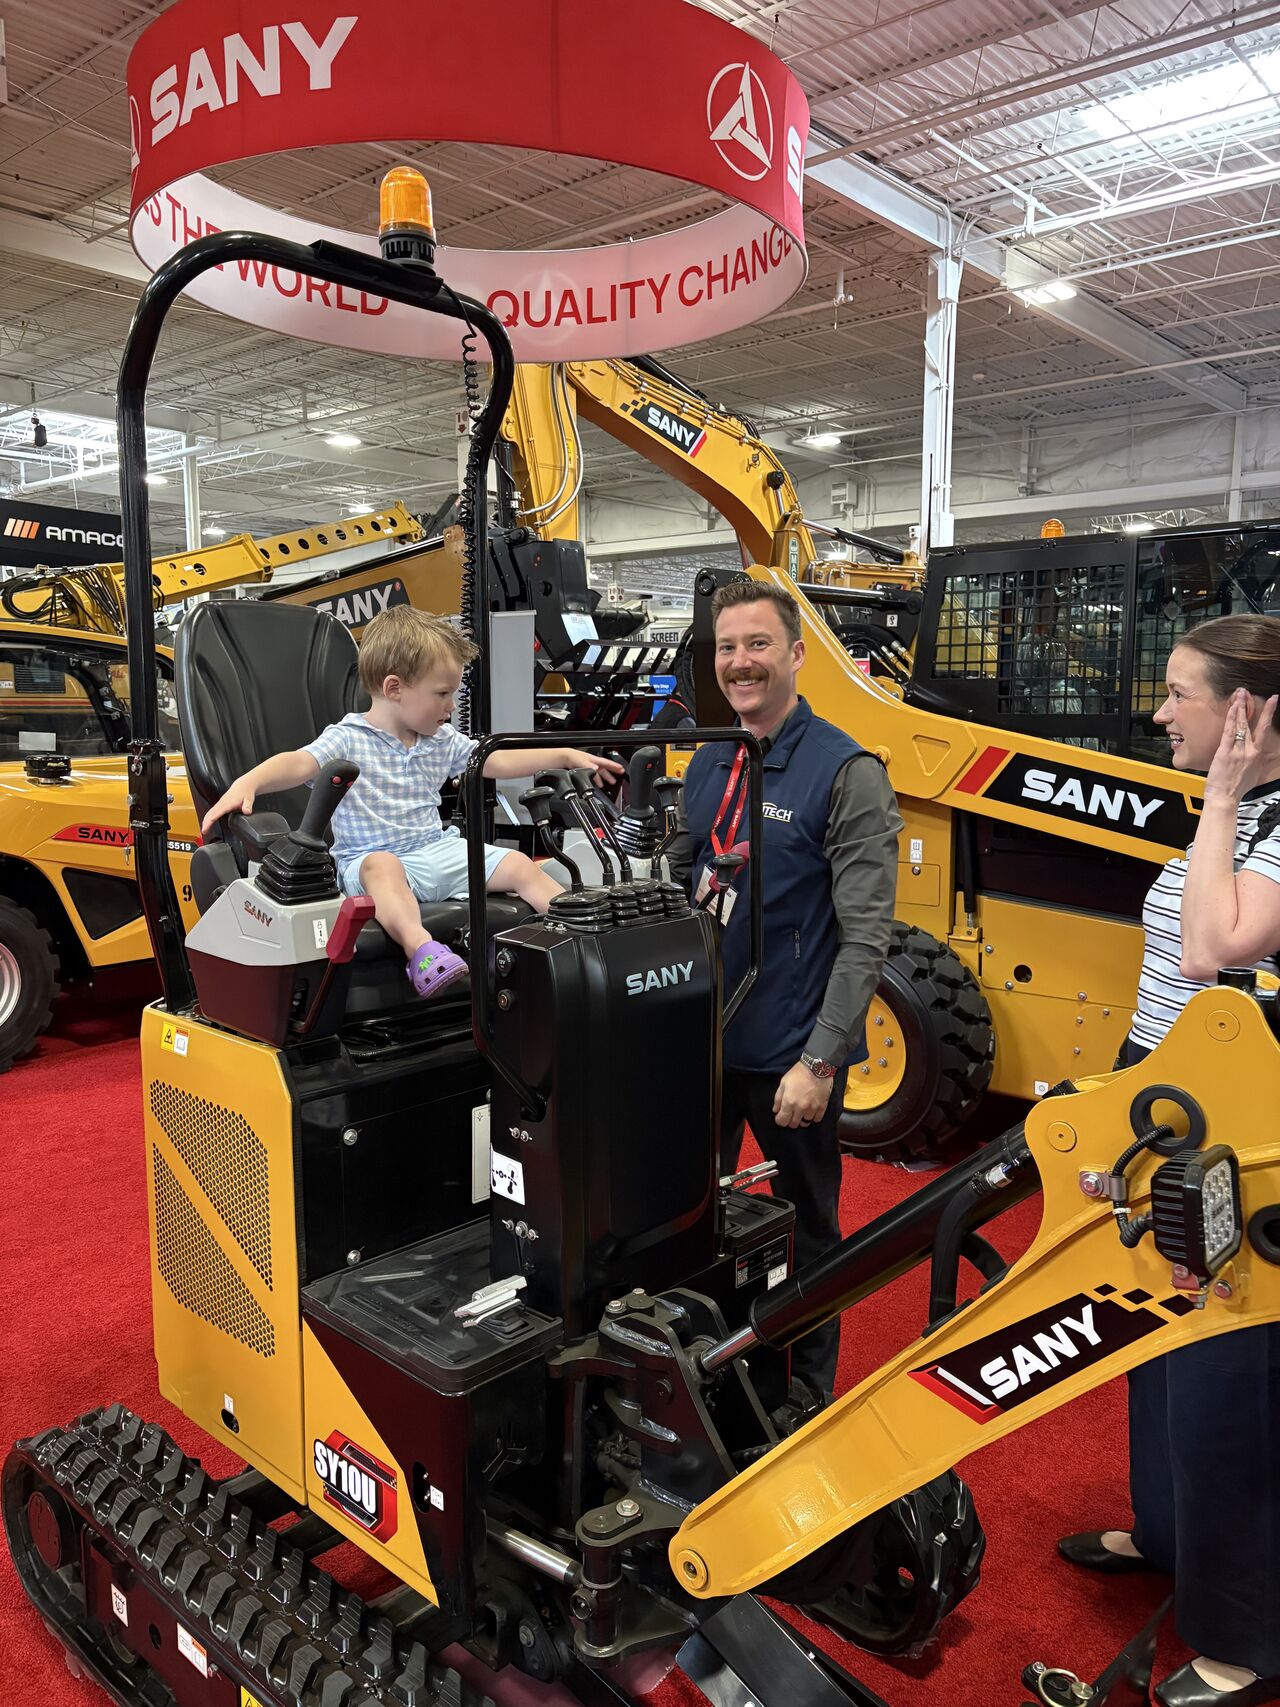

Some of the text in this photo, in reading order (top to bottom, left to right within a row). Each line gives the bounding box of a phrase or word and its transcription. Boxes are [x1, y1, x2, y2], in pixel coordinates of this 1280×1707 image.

[150, 16, 359, 147] SANY
[486, 273, 671, 328] QUALITY
[647, 406, 696, 448] SANY
[650, 631, 679, 643] SCREEN
[1021, 768, 1166, 828] SANY
[78, 827, 129, 843] SANY
[243, 900, 273, 928] SANY
[625, 960, 694, 996] SANY
[979, 1303, 1103, 1400] SANY
[314, 1440, 377, 1515] SY10U
